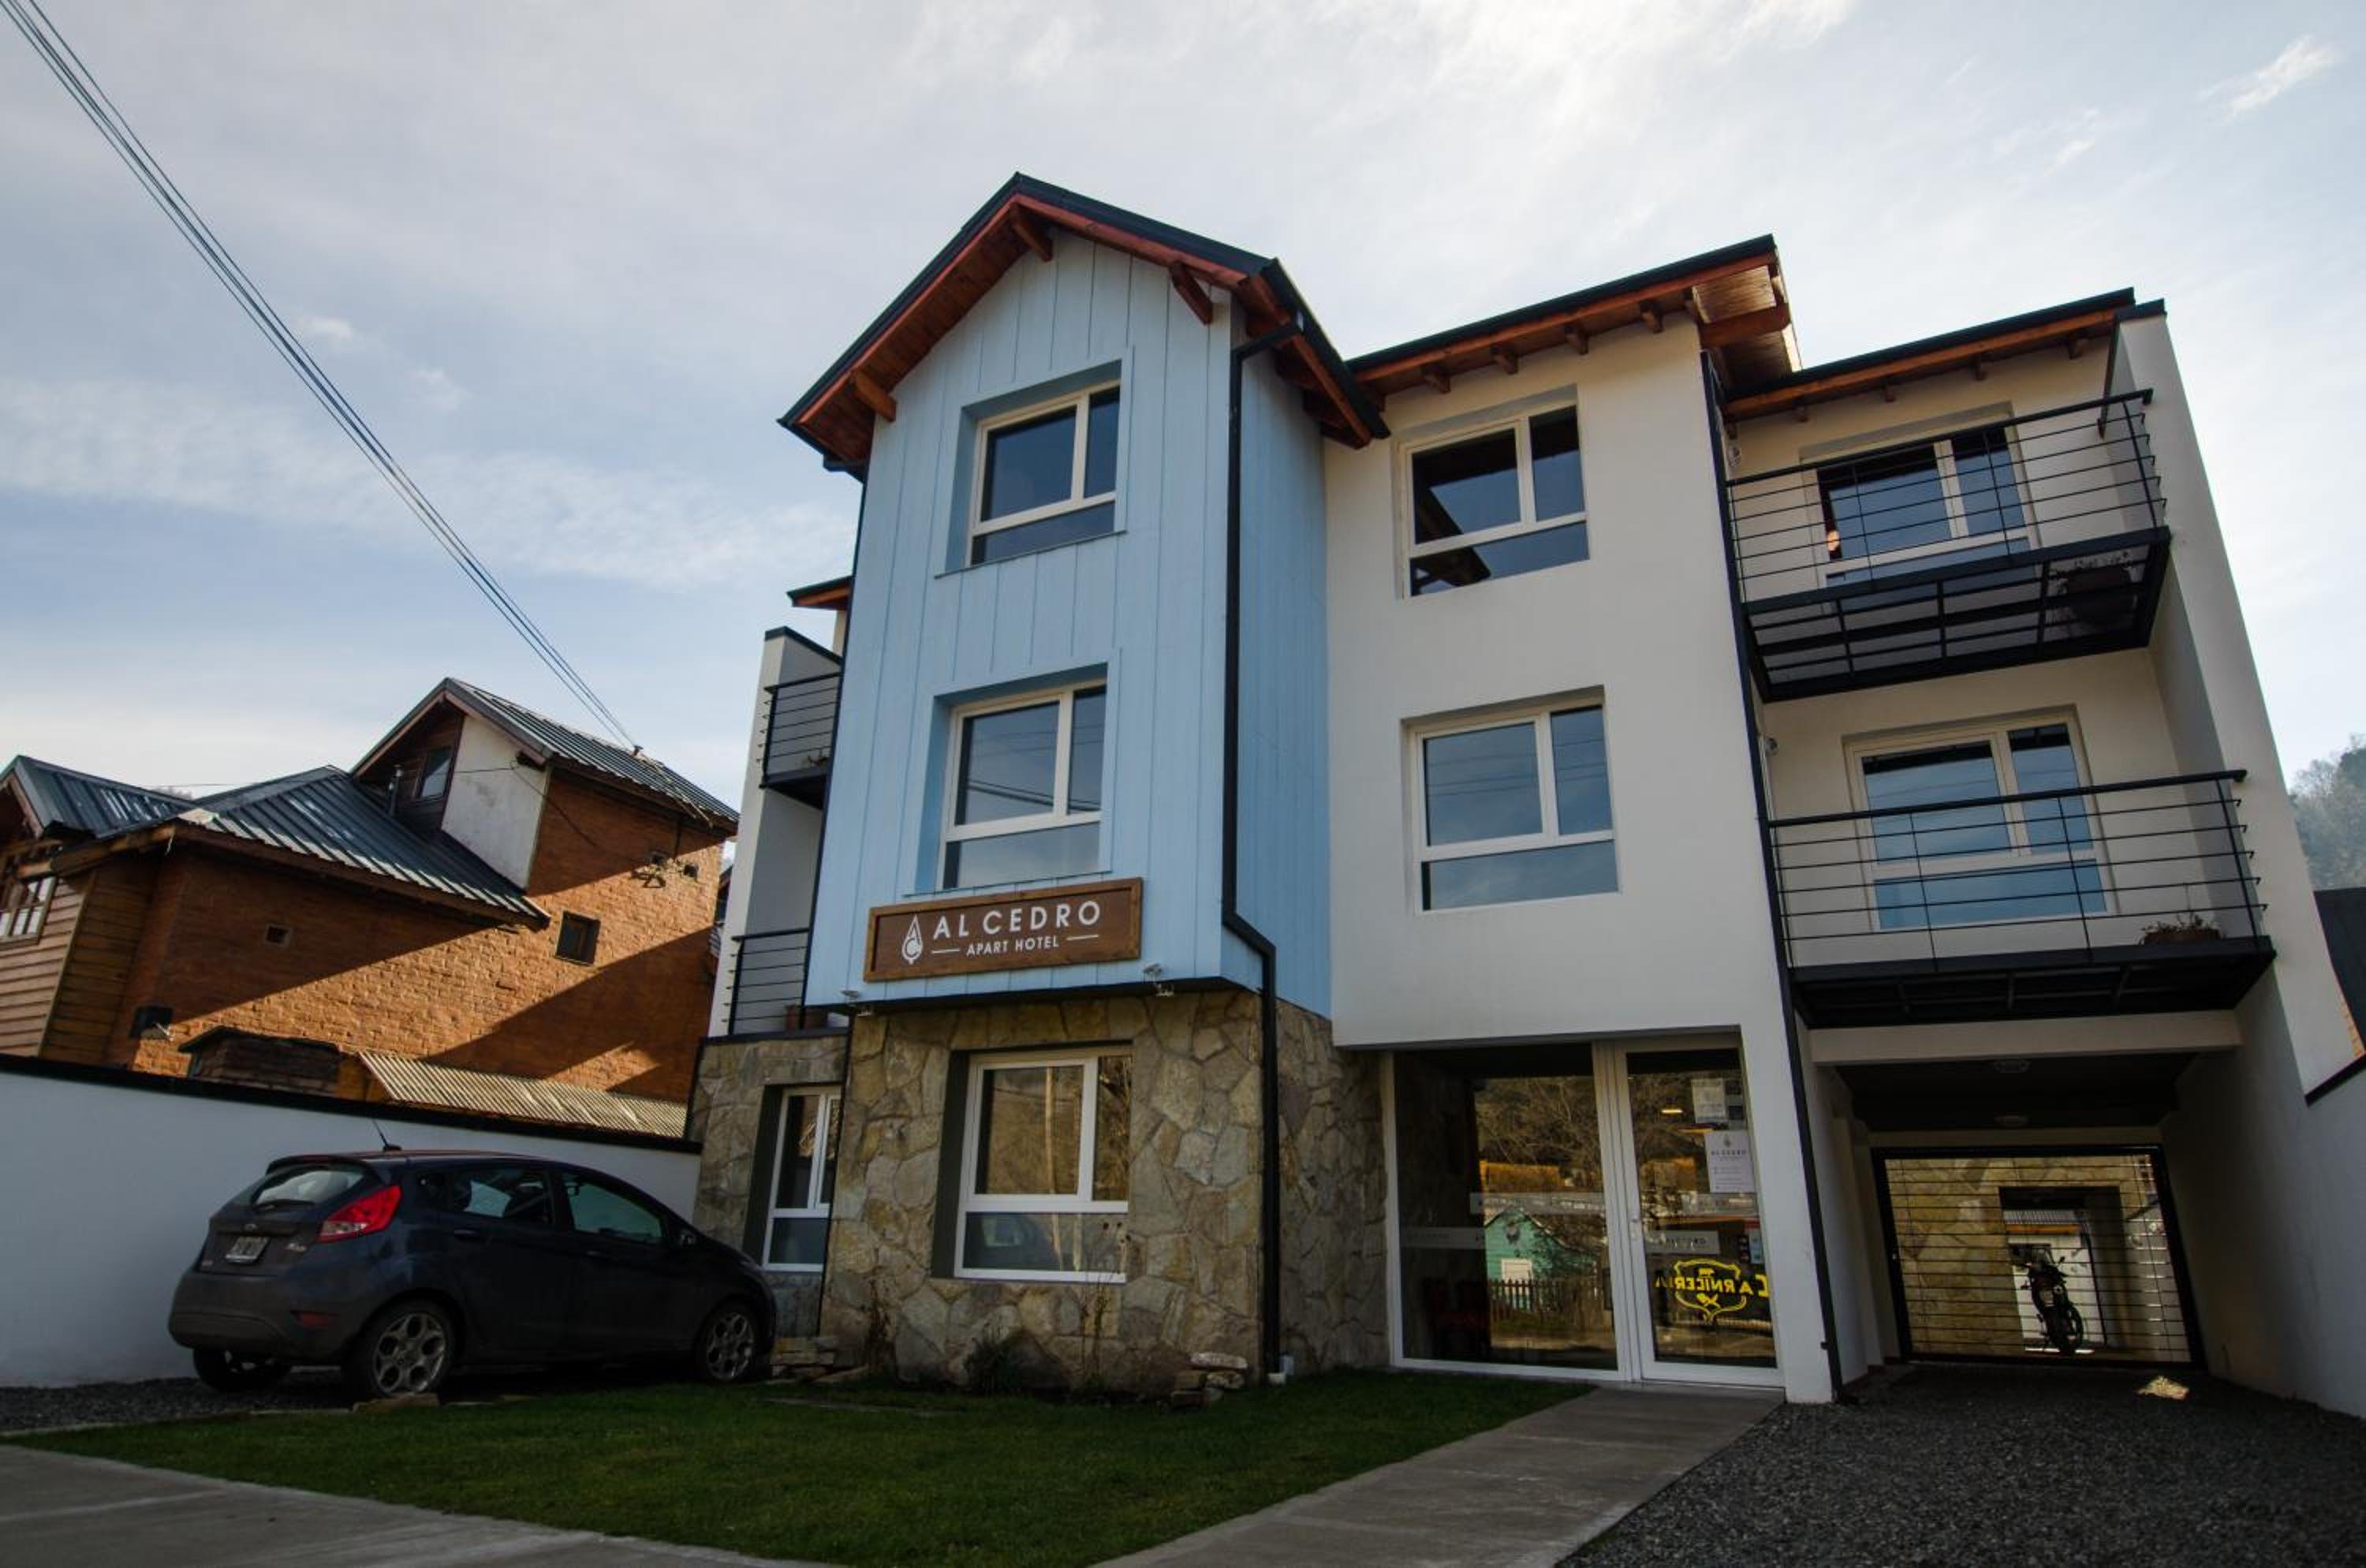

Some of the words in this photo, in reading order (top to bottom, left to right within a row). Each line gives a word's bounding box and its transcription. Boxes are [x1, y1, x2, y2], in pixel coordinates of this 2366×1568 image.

[933, 914, 968, 940] AL
[983, 901, 1100, 935] CEDRO
[967, 940, 1009, 957] APART
[1016, 935, 1059, 951] HOTEL
